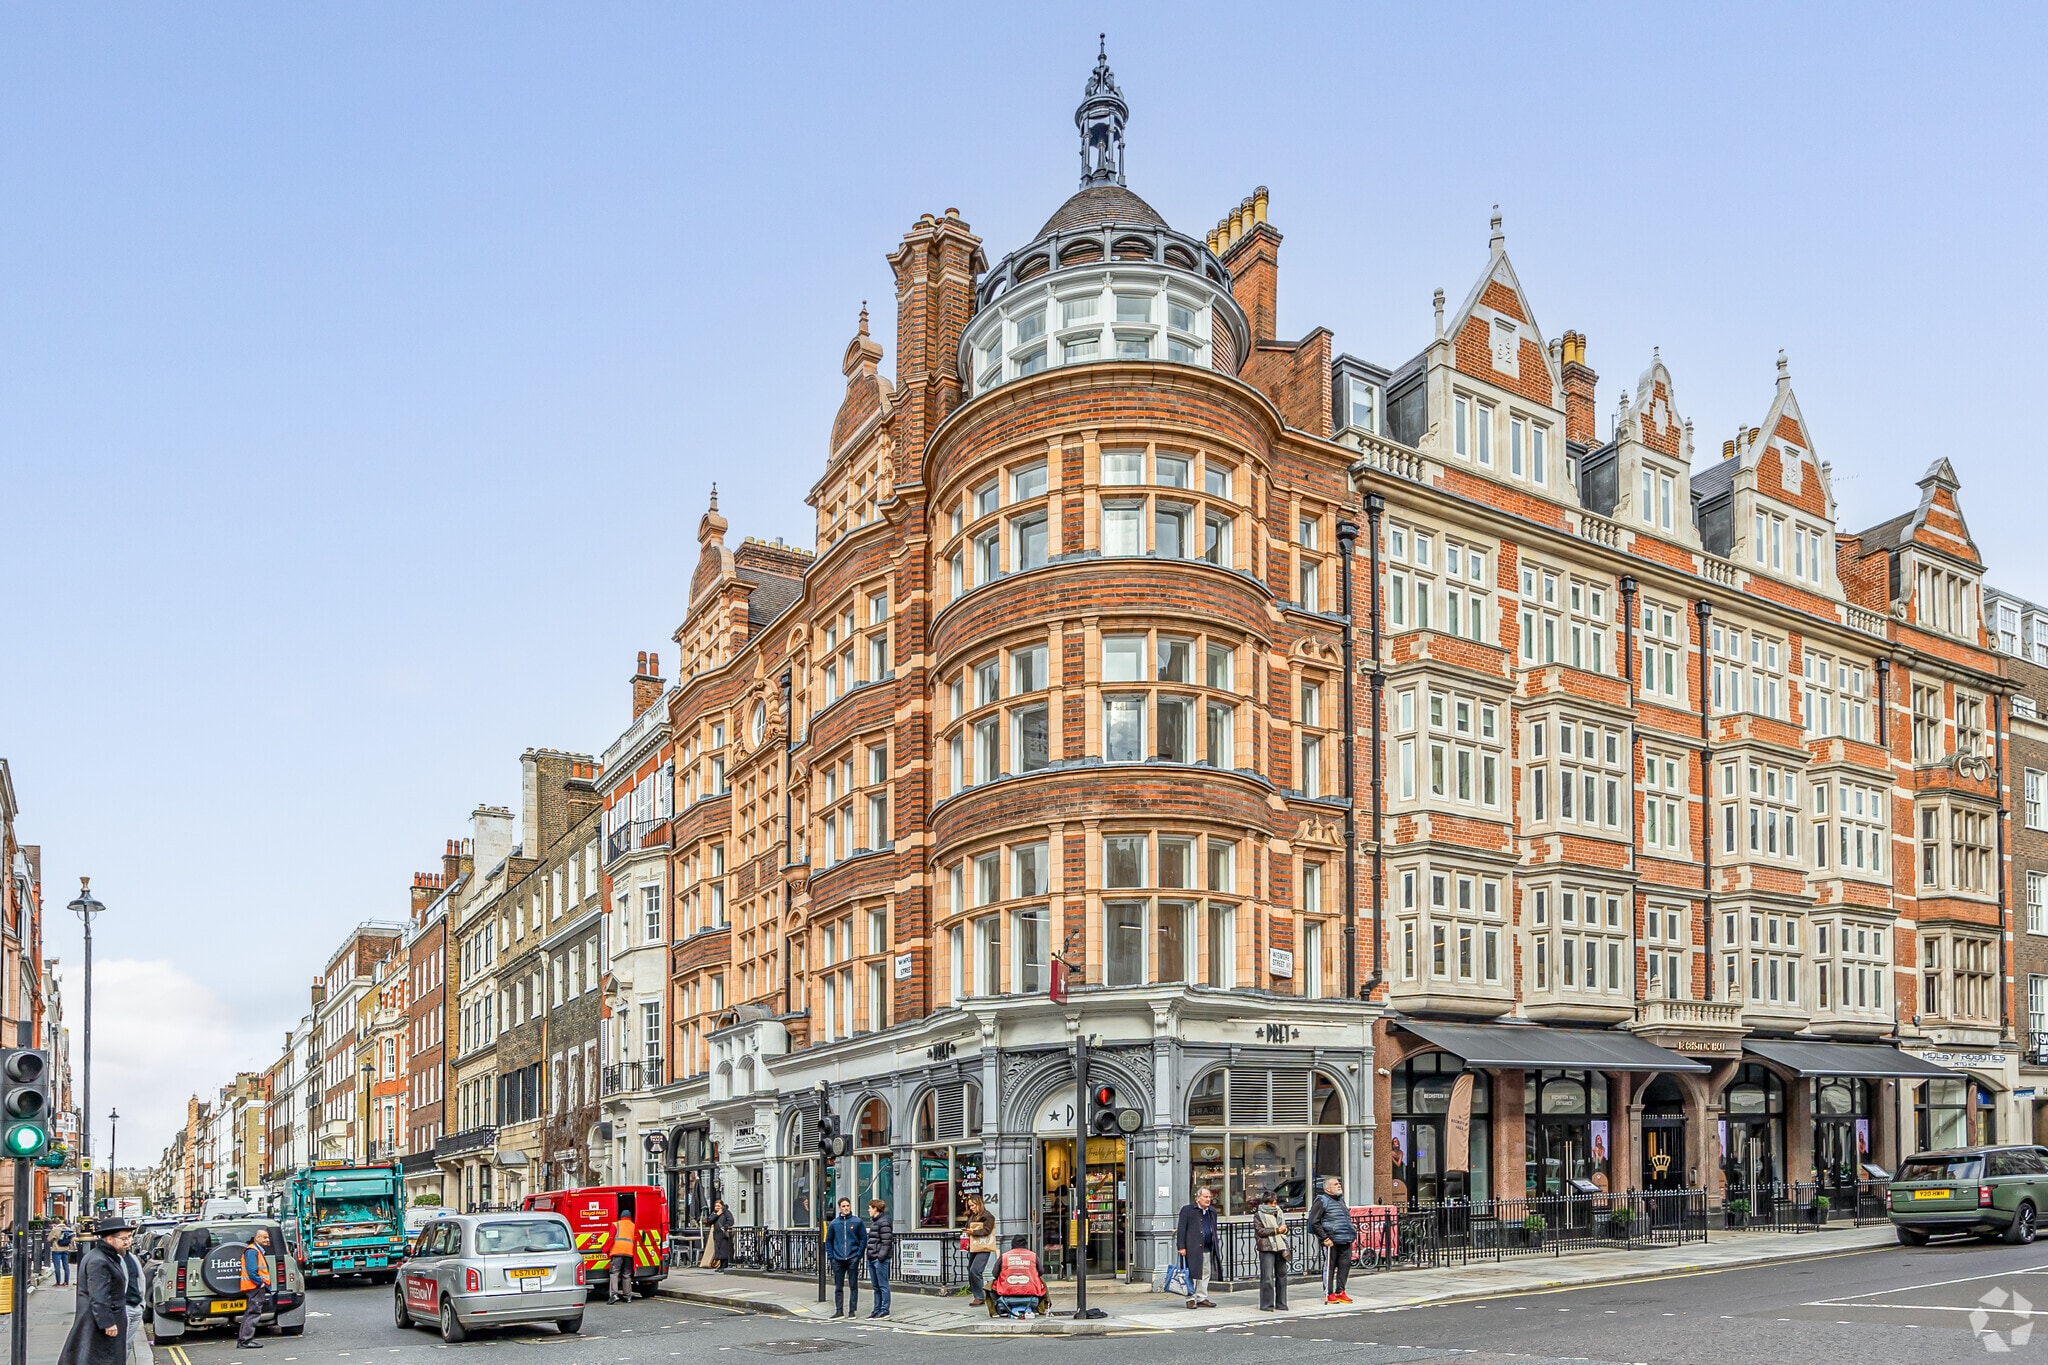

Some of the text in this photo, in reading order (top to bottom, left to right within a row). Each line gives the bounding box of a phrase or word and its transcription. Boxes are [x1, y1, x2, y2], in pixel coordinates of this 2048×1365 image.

[1272, 958, 1285, 968] STREET
[900, 966, 911, 976] STREE
[1266, 1024, 1290, 1044] PRET
[1401, 1123, 1406, 1132] 5
[741, 1189, 747, 1198] 3
[984, 1193, 999, 1204] 24
[211, 1258, 242, 1269] Hatfie
